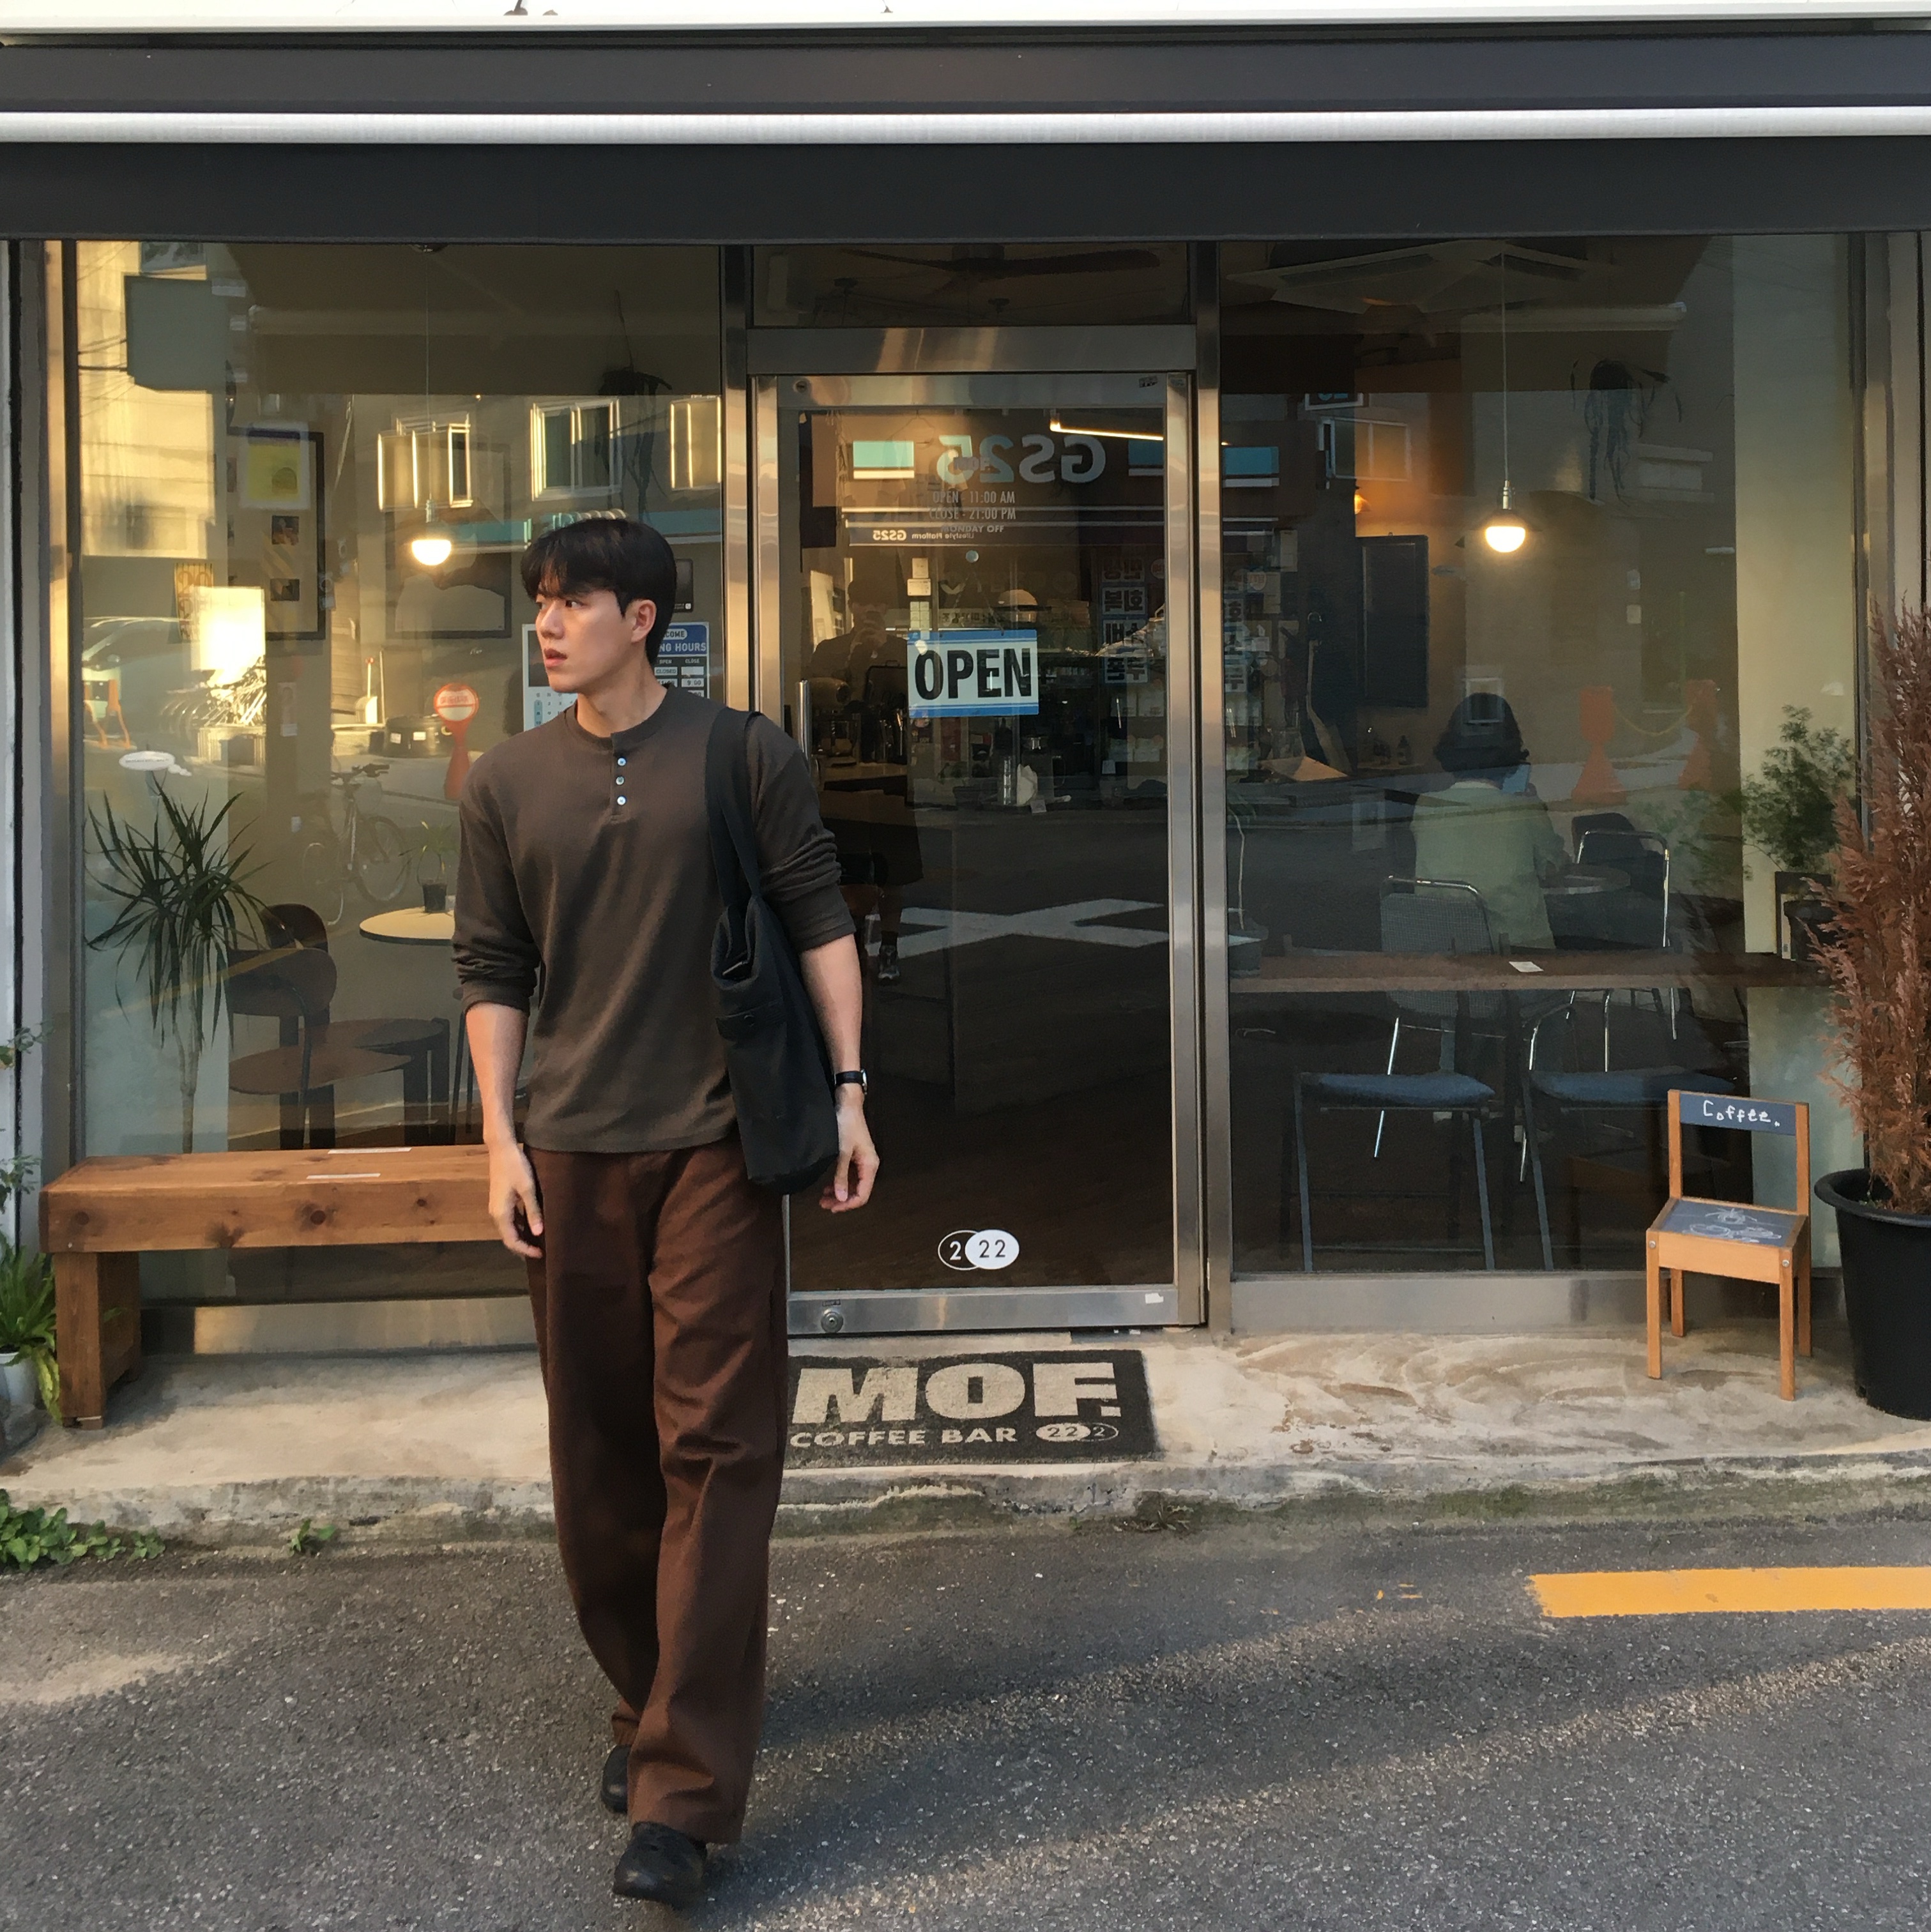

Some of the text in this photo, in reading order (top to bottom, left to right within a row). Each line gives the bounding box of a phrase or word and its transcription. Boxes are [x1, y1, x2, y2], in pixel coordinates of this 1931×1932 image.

[933, 491, 959, 503] OPEN
[970, 491, 996, 503] 11:00
[1000, 491, 1016, 503] AM
[929, 508, 959, 520] CLOSE
[969, 508, 997, 520] 21:00
[1001, 507, 1016, 520] PM
[942, 524, 1005, 533] MONDAY OFF
[675, 643, 706, 651] HOURS
[915, 648, 1032, 701] OPEN
[791, 1362, 1122, 1425] MOF.
[790, 1428, 926, 1449] COFFEE
[942, 1427, 1018, 1445] BAR
